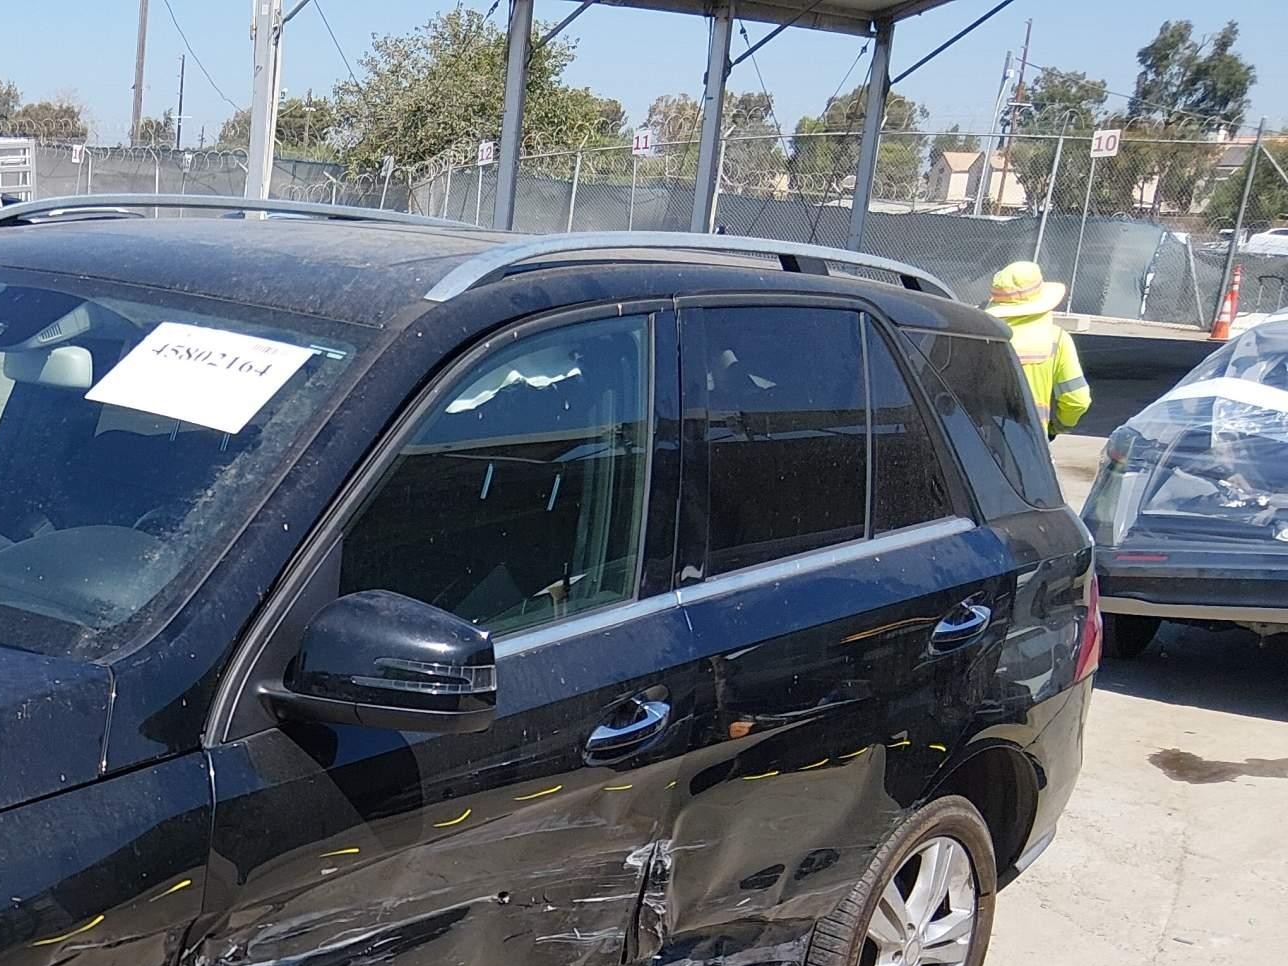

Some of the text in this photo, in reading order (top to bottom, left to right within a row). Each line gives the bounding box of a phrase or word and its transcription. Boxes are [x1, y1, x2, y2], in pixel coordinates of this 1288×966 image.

[633, 134, 650, 151] 11
[1092, 134, 1117, 152] 10
[479, 146, 492, 161] 12
[152, 343, 273, 377] 45802164
